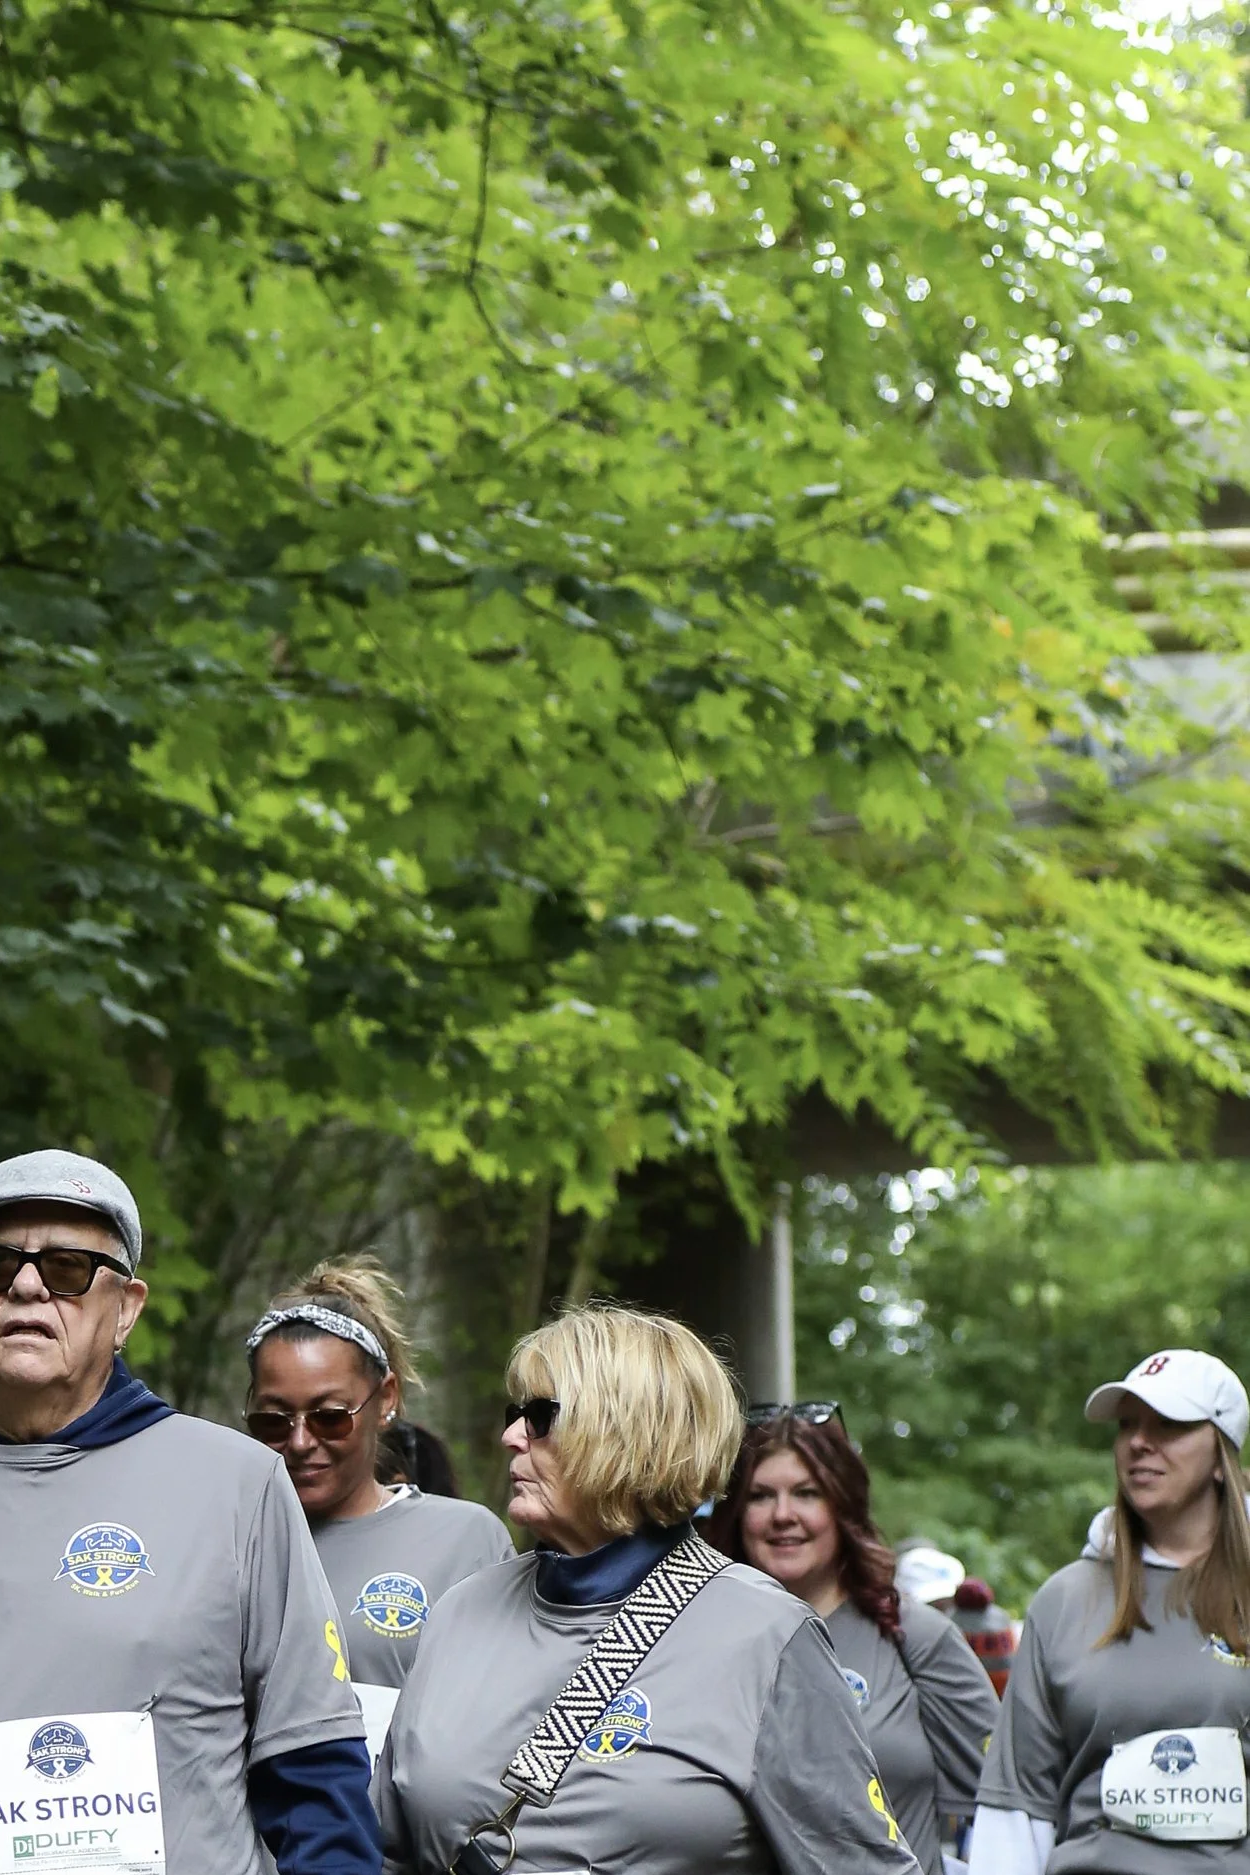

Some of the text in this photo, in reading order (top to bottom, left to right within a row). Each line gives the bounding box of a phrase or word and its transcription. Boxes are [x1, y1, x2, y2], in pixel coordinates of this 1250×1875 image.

[67, 1551, 142, 1566] SAK STRONG
[363, 1594, 424, 1613] SAK STRONG
[604, 1716, 646, 1730] STRONG
[31, 1746, 87, 1759] SAK STRONG
[1105, 1787, 1243, 1805] SAK STRONG
[35, 1791, 157, 1821] STRONG
[1152, 1812, 1214, 1824] DUFFY
[14, 1828, 118, 1856] Di DUFFY
